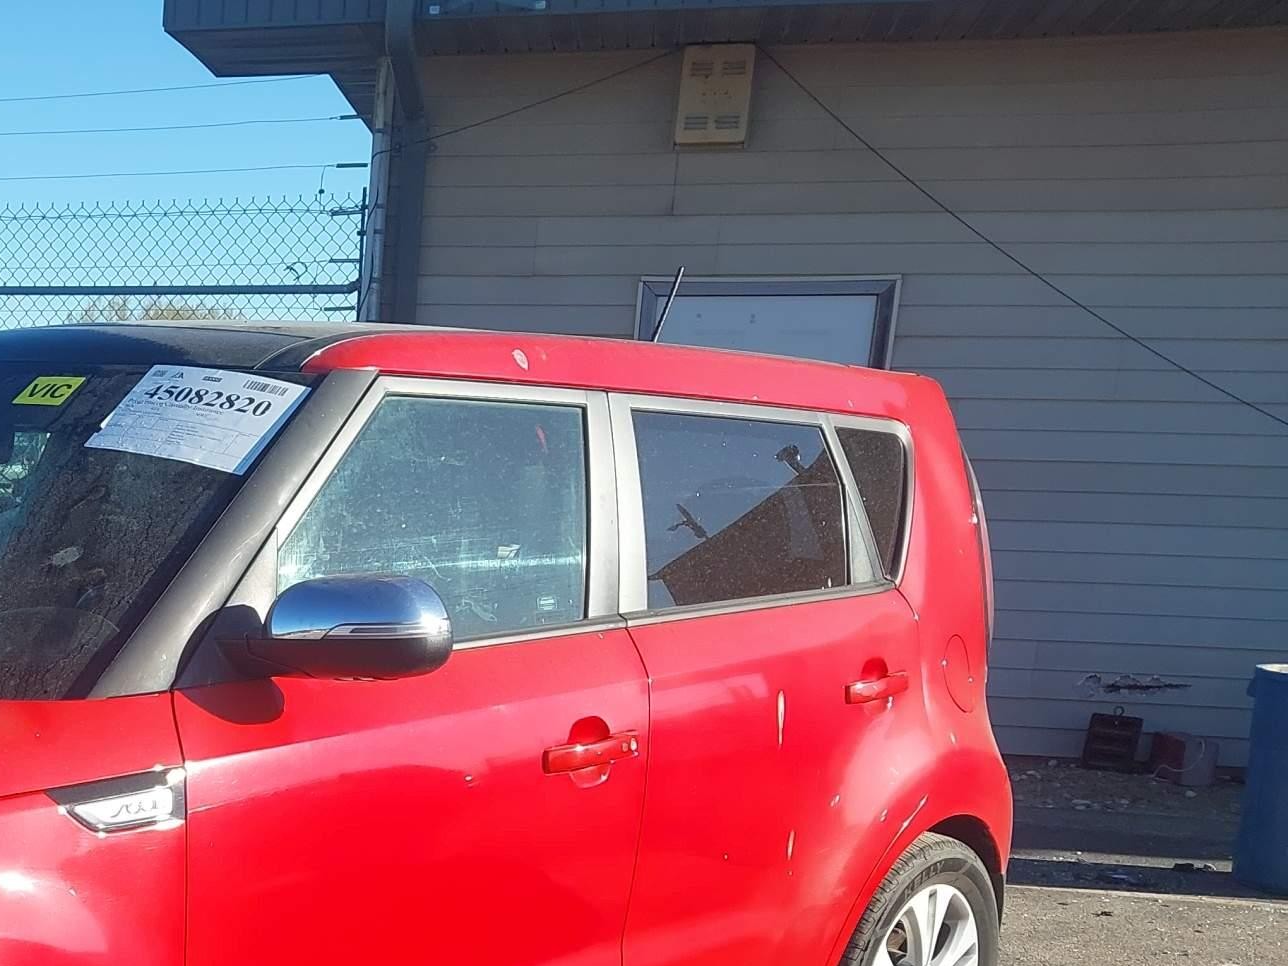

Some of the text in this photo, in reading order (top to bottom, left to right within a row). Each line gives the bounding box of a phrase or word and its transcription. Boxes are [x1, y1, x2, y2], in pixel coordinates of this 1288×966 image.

[27, 382, 73, 399] VIC
[143, 382, 272, 417] 45082820
[904, 860, 946, 901] KELLY
